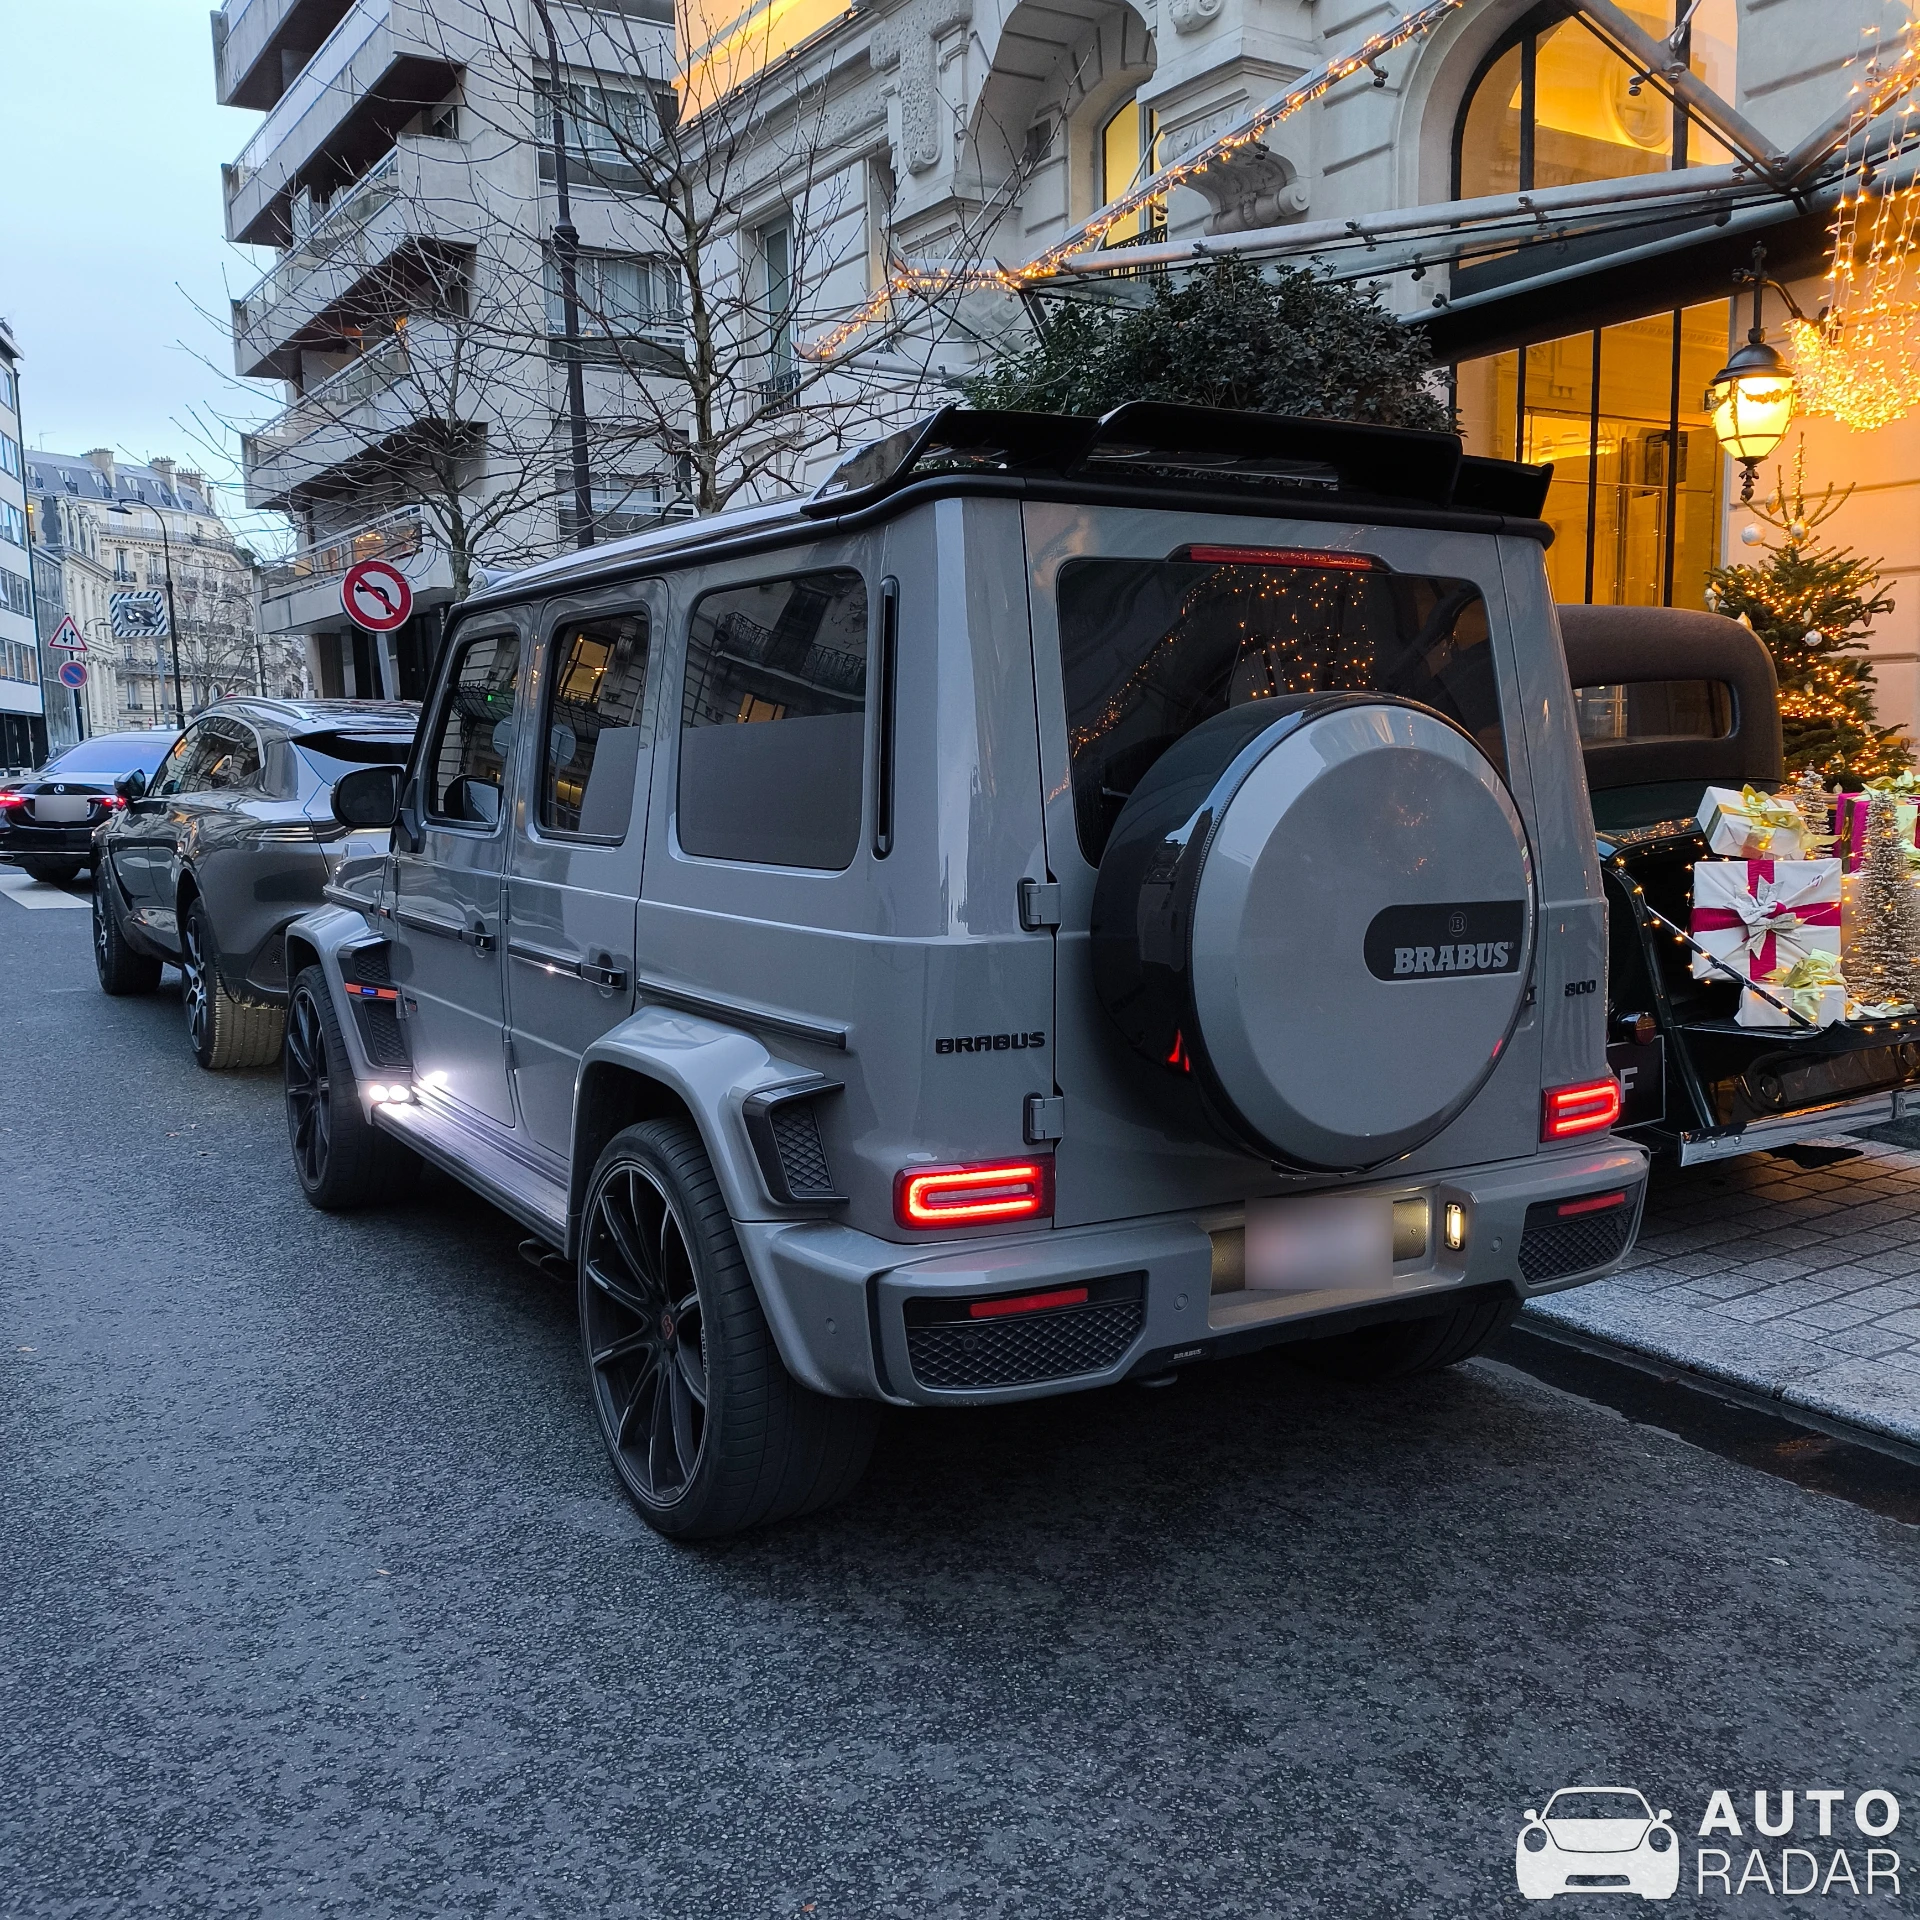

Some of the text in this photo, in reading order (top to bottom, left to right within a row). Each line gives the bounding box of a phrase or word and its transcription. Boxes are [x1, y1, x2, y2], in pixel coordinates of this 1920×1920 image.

[1393, 941, 1510, 974] BRABUS
[1564, 979, 1597, 997] 800
[935, 1031, 1046, 1054] BRABUS
